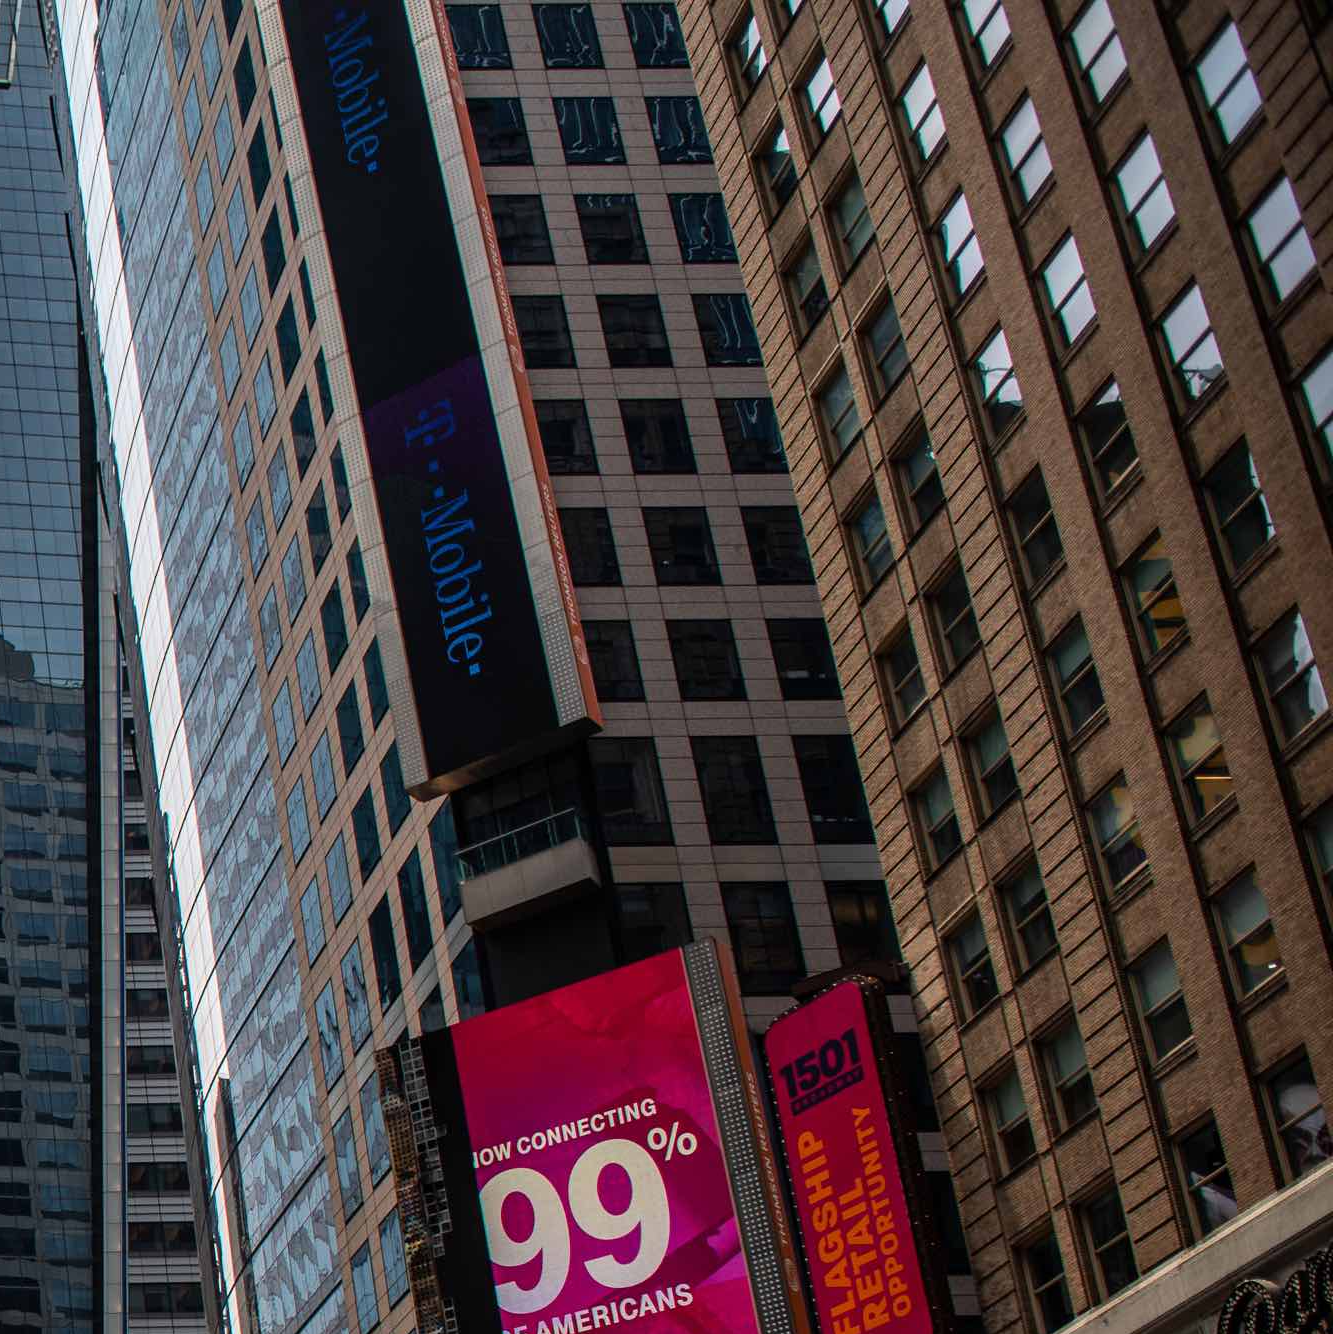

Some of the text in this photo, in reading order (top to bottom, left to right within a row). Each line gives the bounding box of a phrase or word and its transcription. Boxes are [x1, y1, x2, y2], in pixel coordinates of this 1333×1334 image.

[780, 1028, 862, 1098] 1501
[516, 1098, 657, 1156] CONNECTING
[838, 1176, 893, 1333] RETAIL
[851, 1105, 913, 1320] OPPORTUNITY
